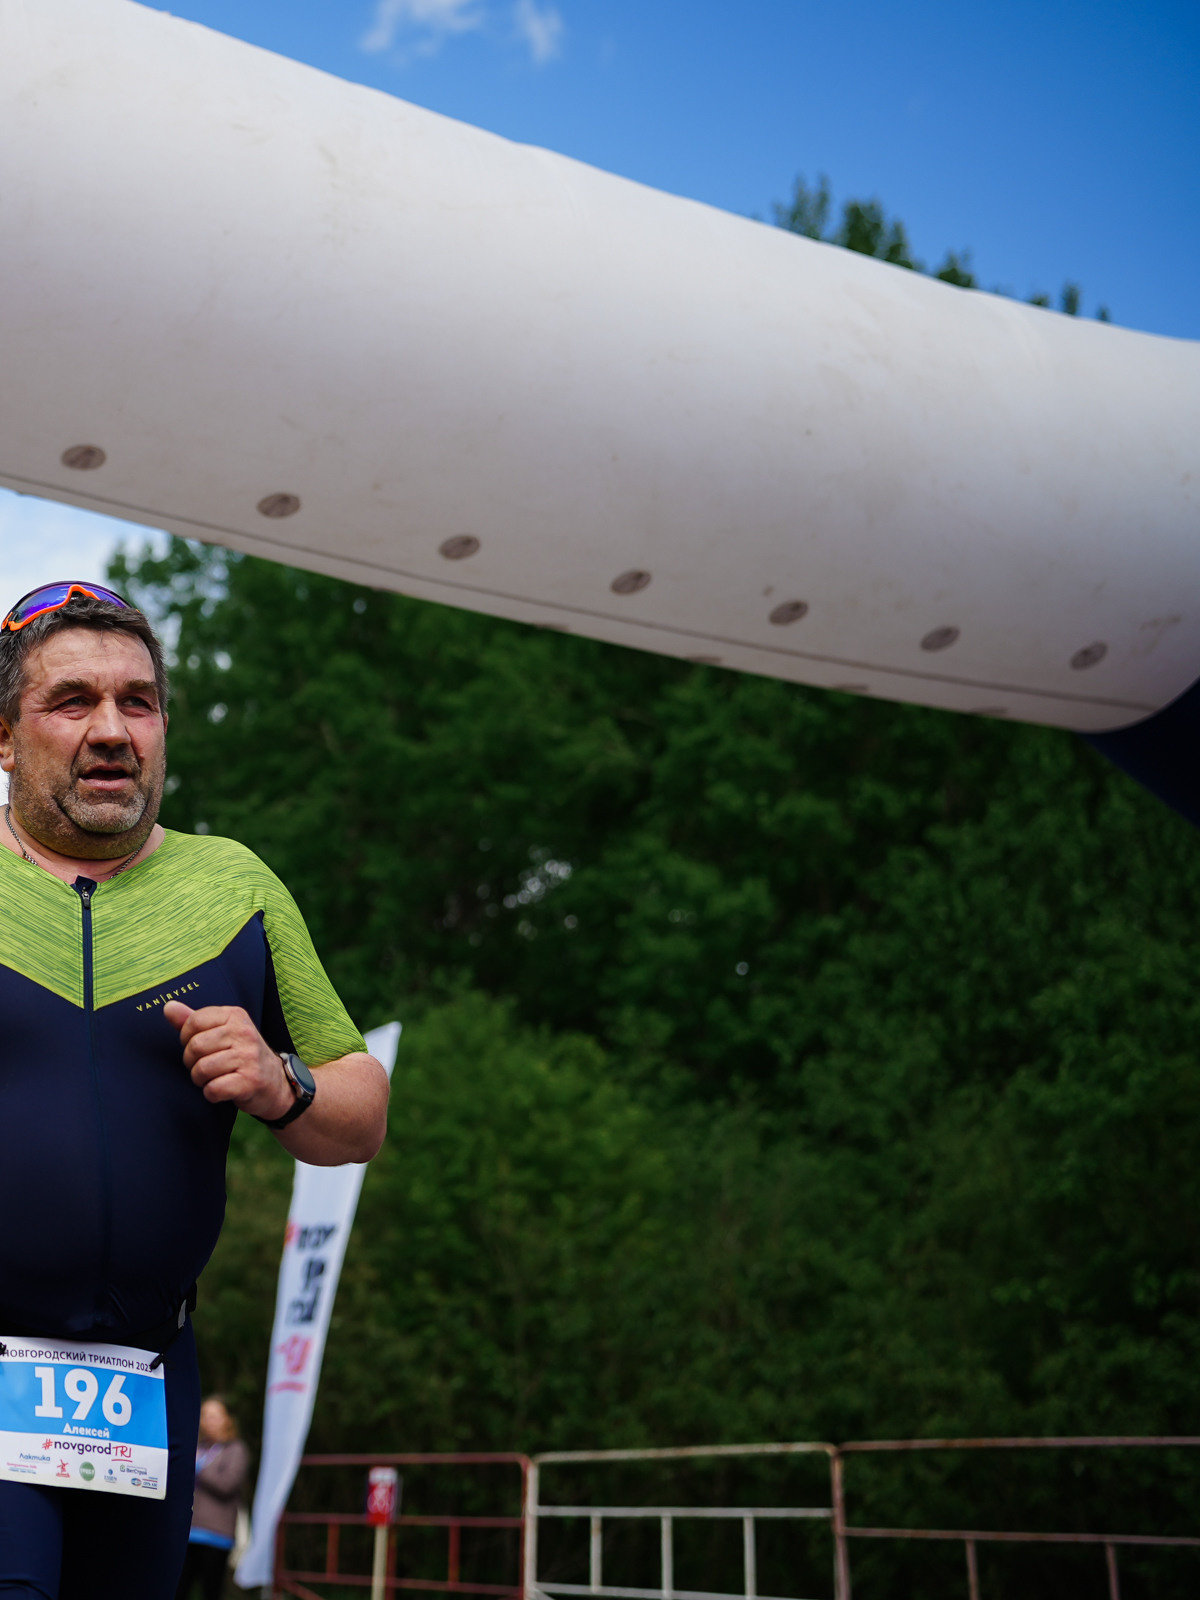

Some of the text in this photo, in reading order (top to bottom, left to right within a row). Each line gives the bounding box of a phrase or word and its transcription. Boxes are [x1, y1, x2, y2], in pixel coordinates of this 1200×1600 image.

[88, 1353, 134, 1369] ТРИАТЛОН
[34, 1366, 132, 1426] 196
[62, 1422, 110, 1439] Алексей
